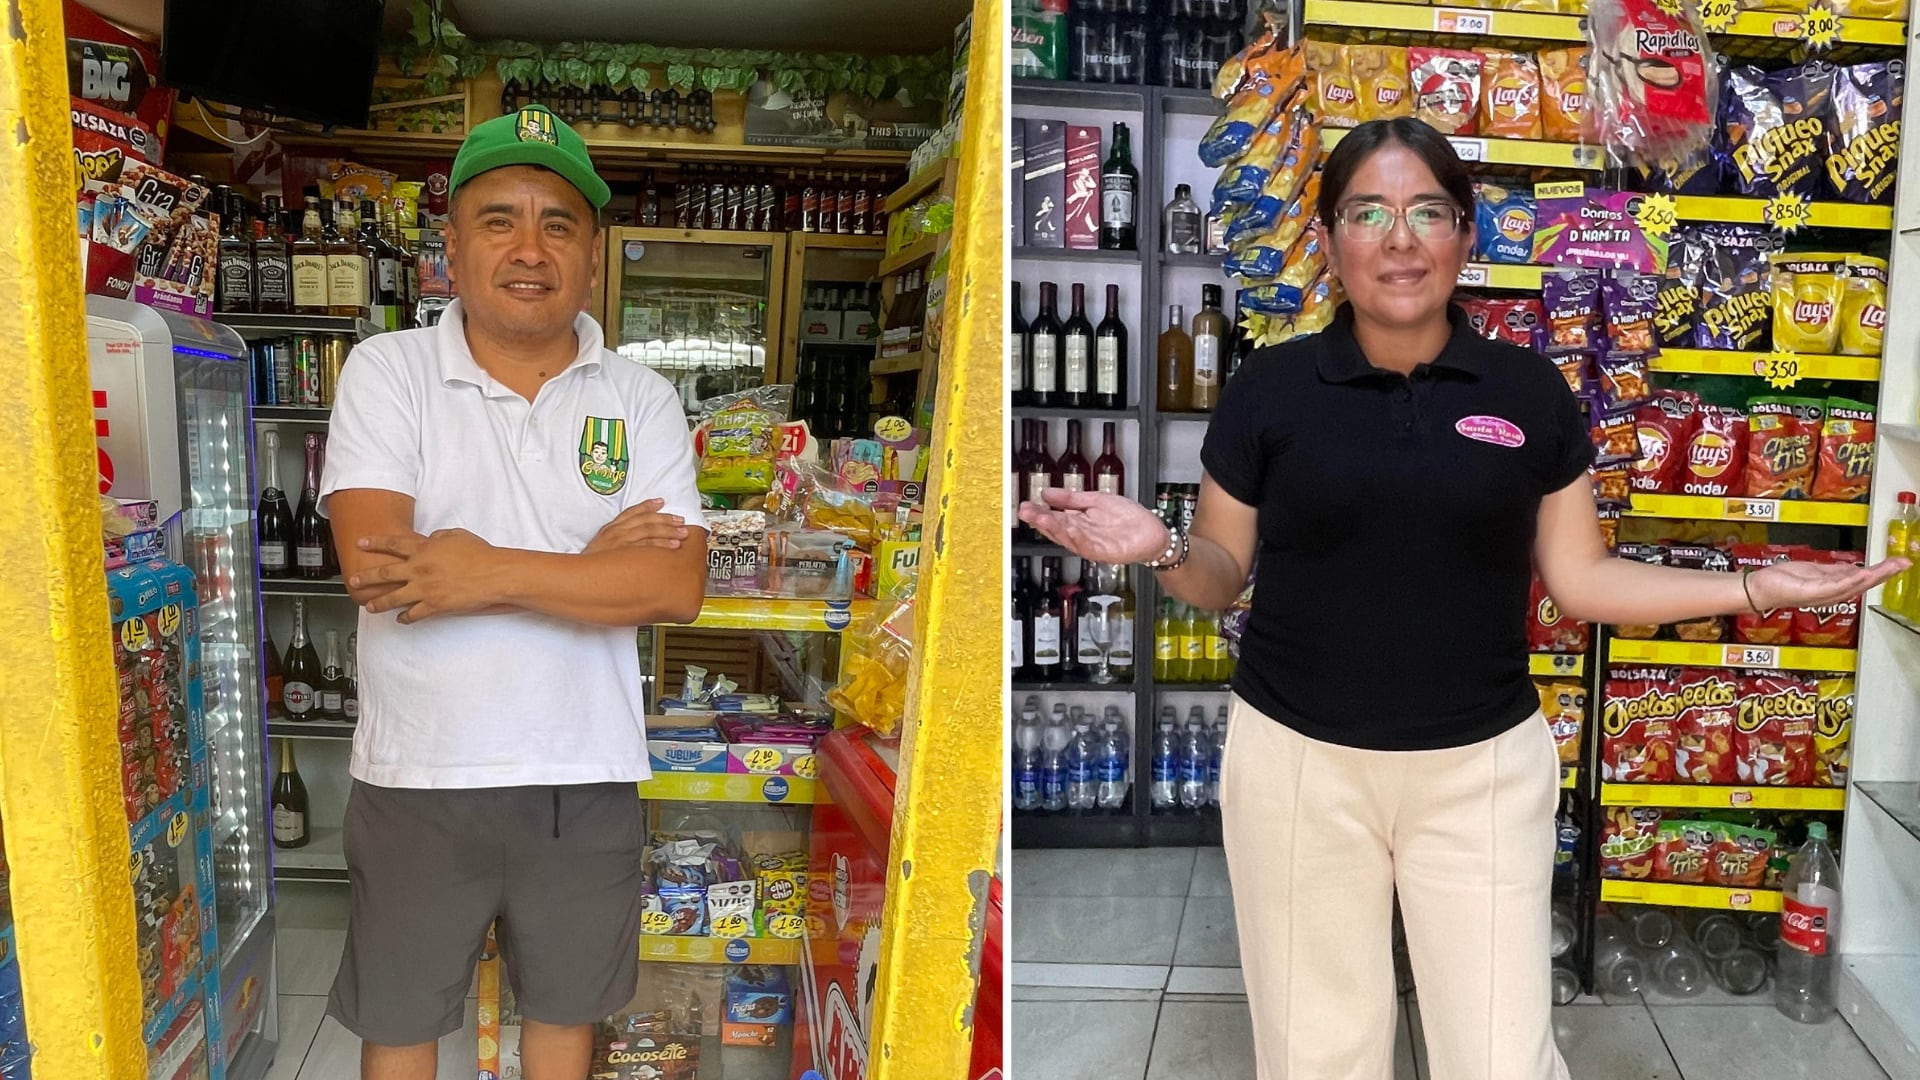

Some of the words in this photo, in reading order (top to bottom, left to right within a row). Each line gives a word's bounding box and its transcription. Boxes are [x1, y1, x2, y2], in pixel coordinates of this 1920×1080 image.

[1460, 17, 1483, 29] 2.00
[1808, 18, 1833, 36] 8.00
[1635, 29, 1700, 54] Rapiditas
[82, 58, 130, 101] BIG
[72, 111, 127, 140] OLSAZA
[871, 126, 890, 137] THIS
[895, 127, 904, 136] IS
[1764, 138, 1817, 183] Snax
[1538, 185, 1581, 195] NUEVOS
[1580, 206, 1622, 221] Doritos
[1703, 291, 1772, 338] Piqueo
[1728, 306, 1767, 340] Snax
[1763, 432, 1811, 457] Cheese
[1684, 482, 1729, 496] ondas
[1748, 503, 1772, 515] 3.50
[710, 550, 732, 568] Gra
[735, 546, 756, 565] Gra
[709, 567, 731, 580] nuts
[1746, 651, 1770, 662] 3.60
[1737, 690, 1818, 731] Cheetos
[665, 749, 703, 761] SUBLIME
[1673, 857, 1700, 875] tris
[1720, 860, 1749, 876] tris
[770, 880, 792, 891] chin
[771, 890, 793, 900] chin
[608, 1043, 687, 1064] Cocosette
